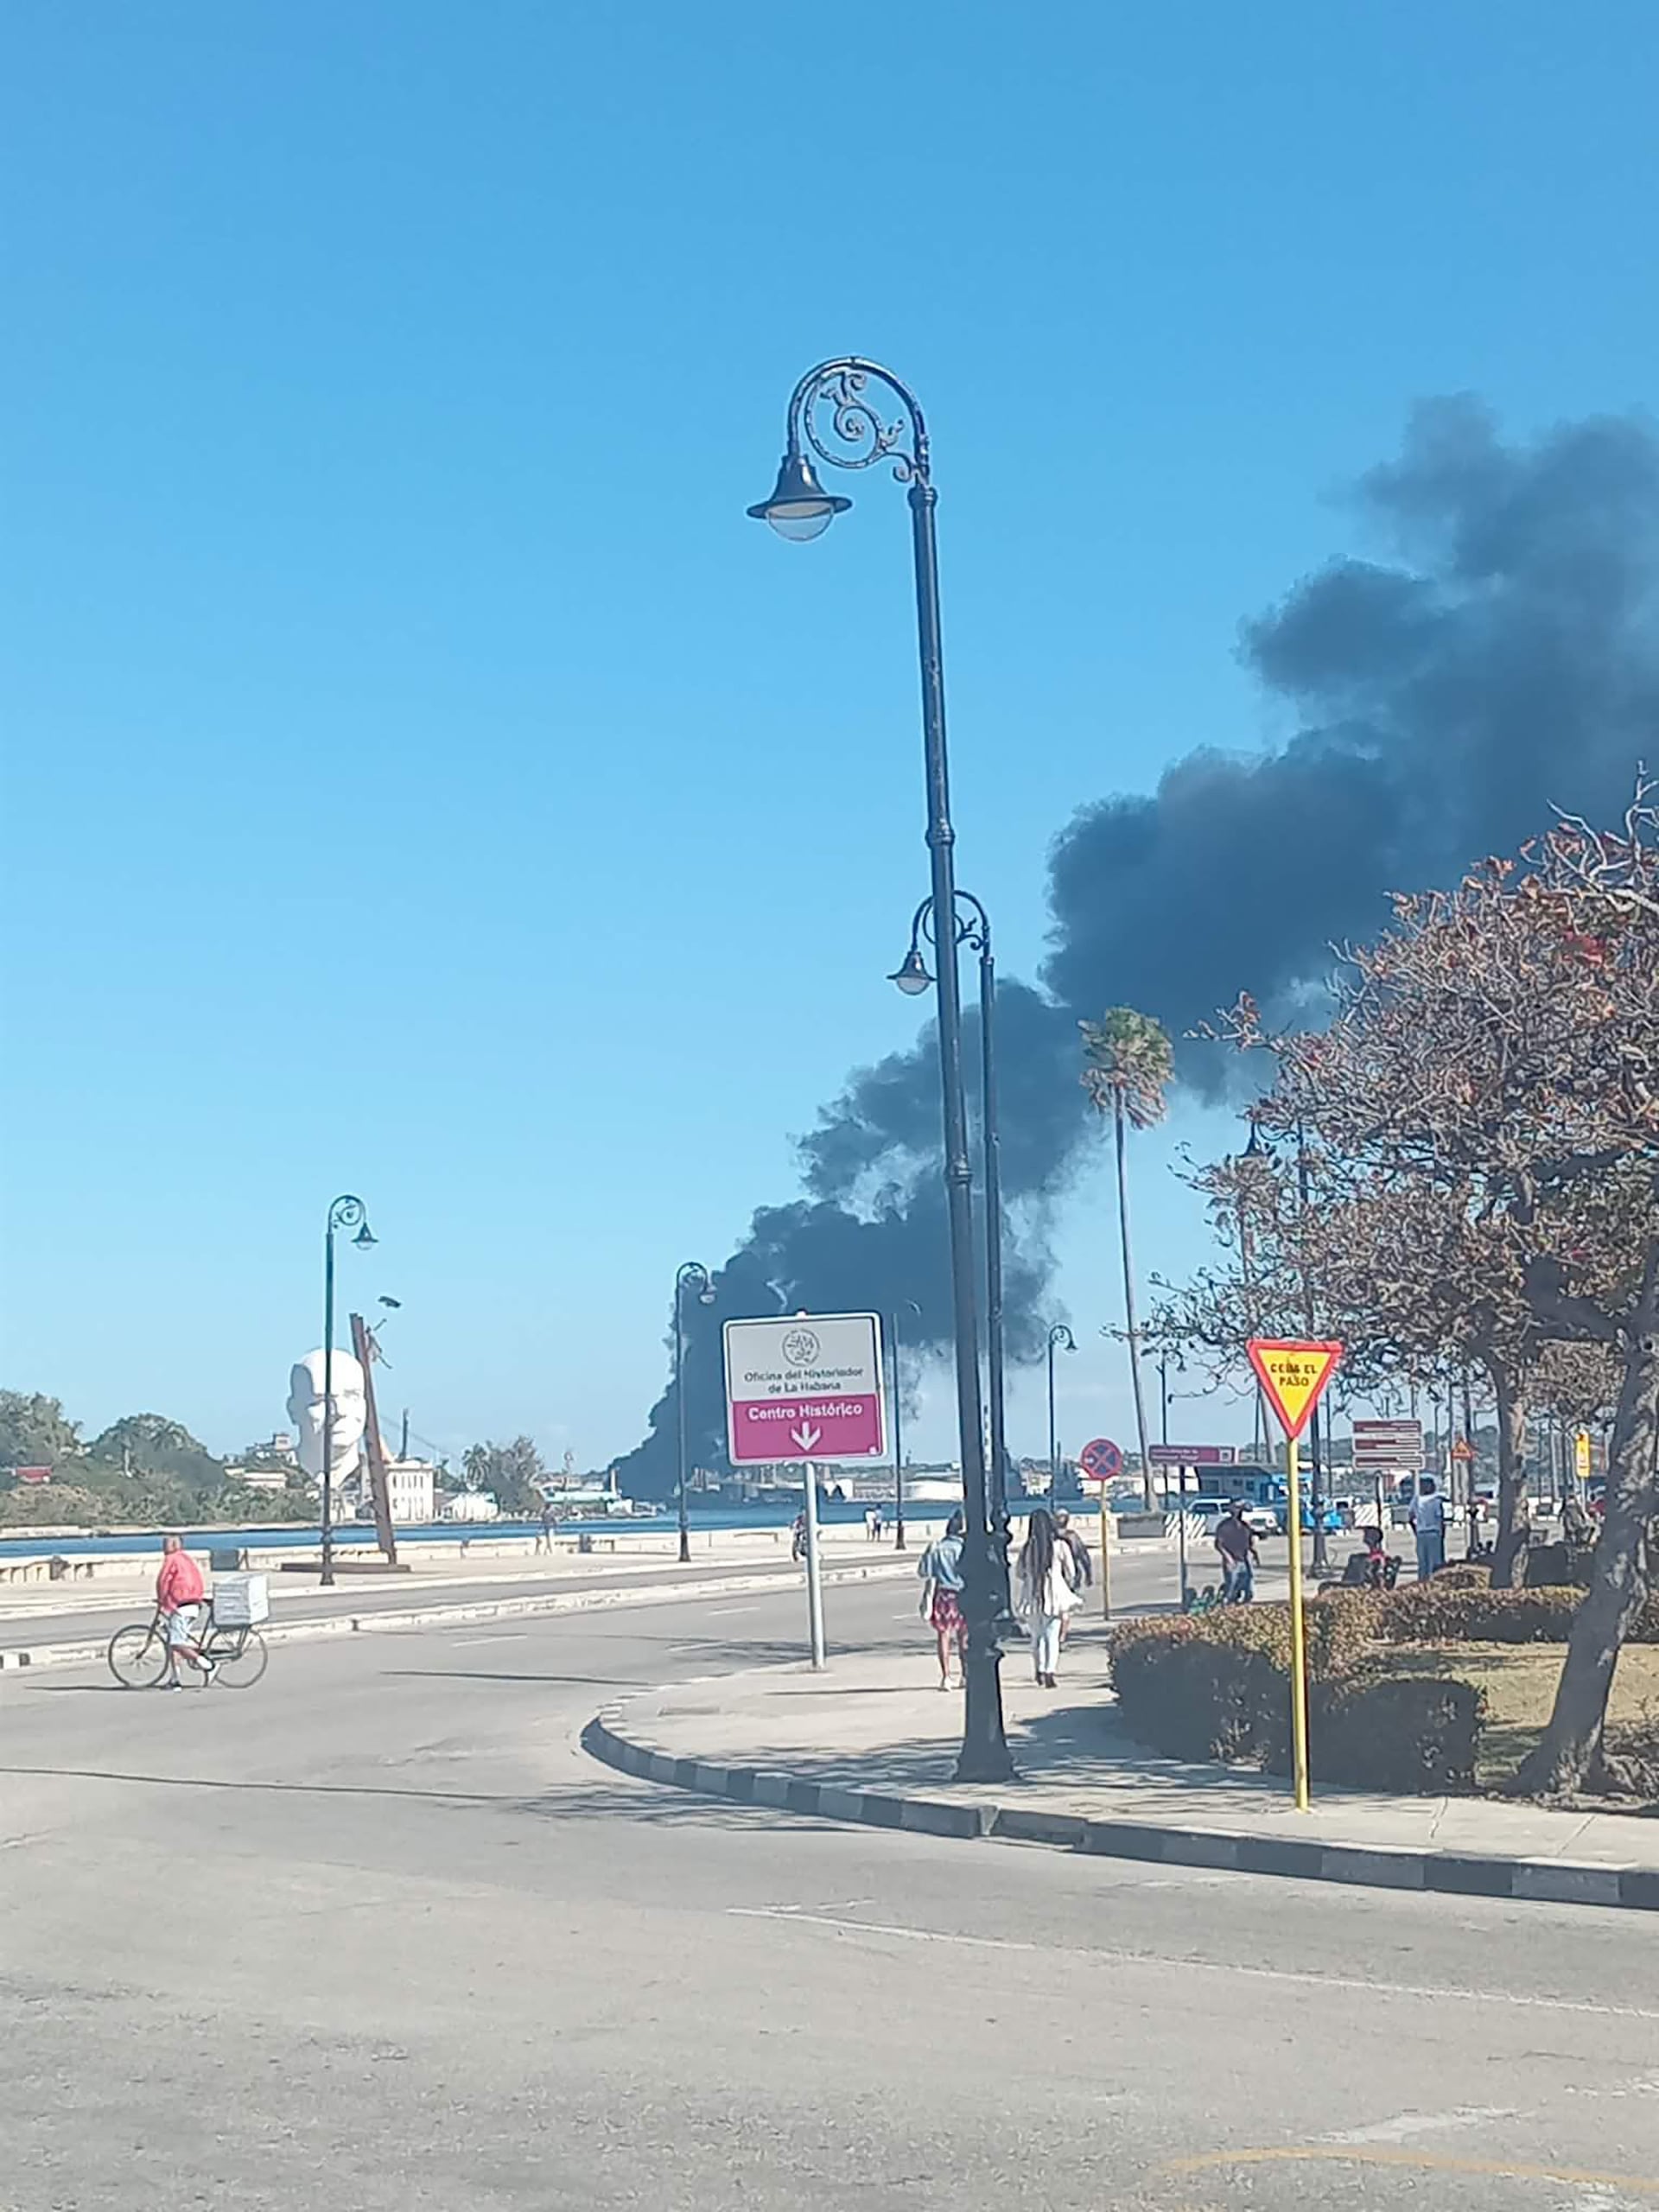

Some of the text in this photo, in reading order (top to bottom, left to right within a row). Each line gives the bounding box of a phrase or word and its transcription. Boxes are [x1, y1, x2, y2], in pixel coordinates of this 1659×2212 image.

[744, 1367, 864, 1382] Oficina del Historiador
[1304, 1364, 1318, 1374] EL
[768, 1381, 842, 1394] de La Habana
[1279, 1376, 1309, 1387] PASO
[748, 1402, 863, 1421] Centro Histórico
